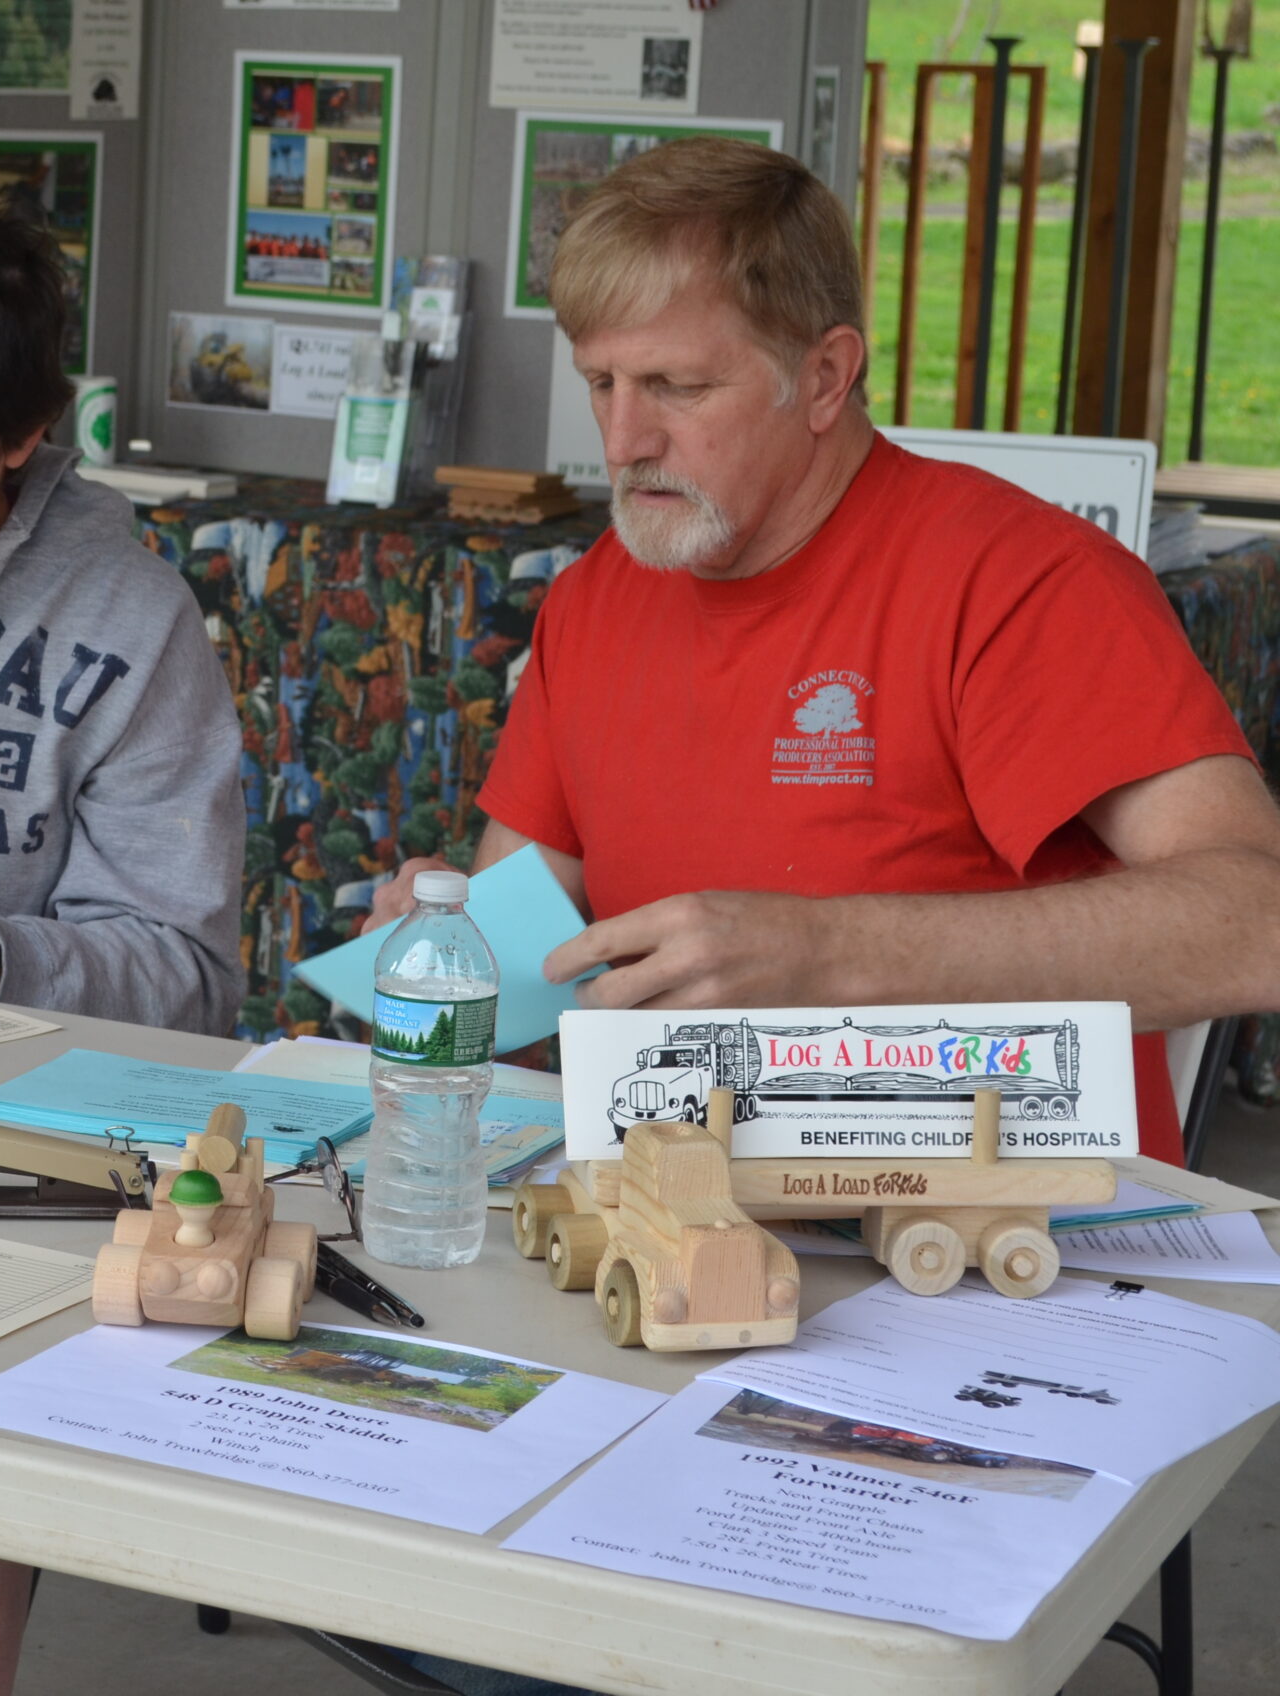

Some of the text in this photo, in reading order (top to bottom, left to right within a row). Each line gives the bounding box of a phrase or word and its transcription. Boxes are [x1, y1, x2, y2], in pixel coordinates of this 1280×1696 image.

[841, 736, 876, 750] TIMBER
[771, 774, 874, 787] www.timproct.org
[833, 1039, 854, 1067] A
[986, 1038, 1032, 1075] Kids
[801, 1131, 1121, 1148] BENEFITING CHILDR'S HOSPITALS
[816, 1174, 826, 1195] A
[160, 1390, 408, 1445] 548 D Grapple Skidder
[216, 1386, 390, 1426] 1989 John Deere
[48, 1415, 112, 1434] Contact:
[120, 1431, 158, 1444] John
[164, 1440, 256, 1465] Trowbridge
[258, 1461, 279, 1470] @
[205, 1424, 233, 1434] sets
[238, 1431, 258, 1439] of
[259, 1434, 310, 1451] chains
[212, 1436, 262, 1453] Winch
[286, 1427, 325, 1440] Tires
[740, 1454, 979, 1504] 1992 Valmet 546F
[773, 1471, 918, 1506] Forwarder
[723, 1488, 924, 1535] Tracks and Front Chains
[777, 1488, 887, 1515] New Grapple
[696, 1506, 736, 1520] Ford
[740, 1515, 798, 1532] Engine
[818, 1531, 860, 1544] 4000
[865, 1540, 912, 1554] hours
[731, 1502, 896, 1540] Updated Front Axle
[570, 1535, 640, 1555] Contact:
[650, 1551, 691, 1566] John
[708, 1521, 752, 1535] Clark
[774, 1534, 827, 1550] Speed
[832, 1544, 879, 1559] Trans
[756, 1540, 801, 1556] Front
[809, 1551, 850, 1565] Tires
[778, 1556, 820, 1570] Rear
[826, 1566, 868, 1580] Tires
